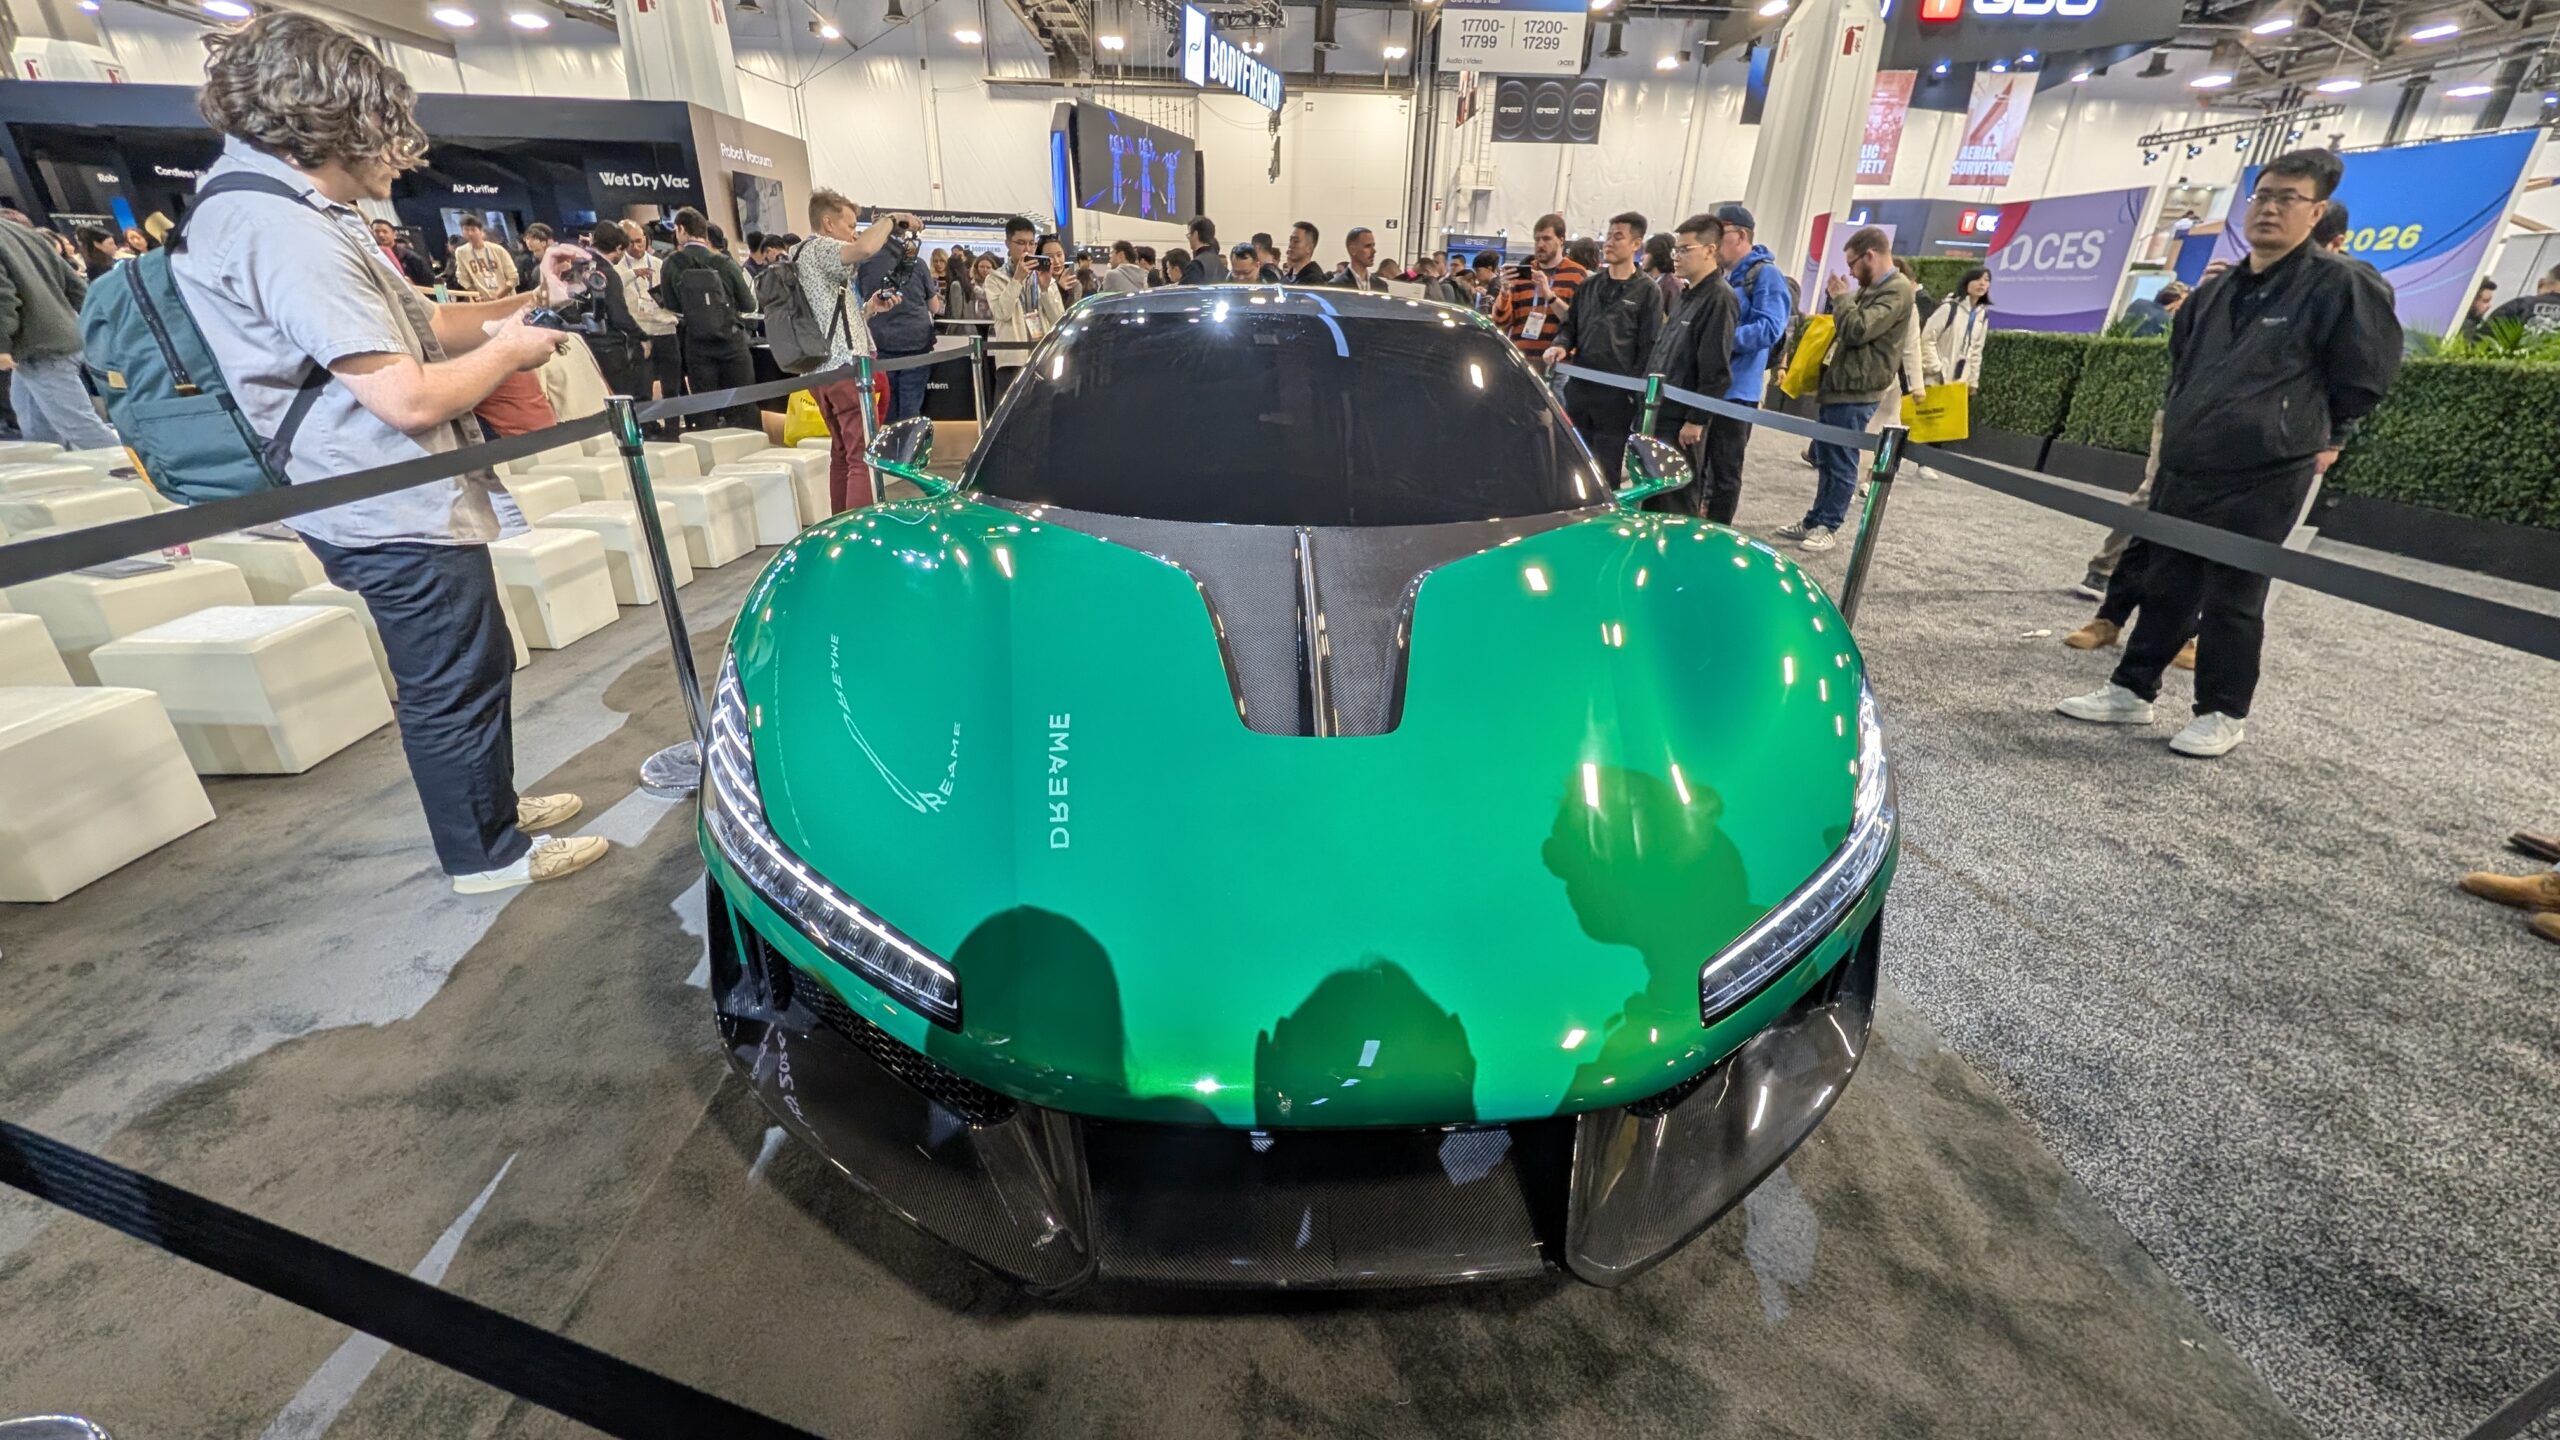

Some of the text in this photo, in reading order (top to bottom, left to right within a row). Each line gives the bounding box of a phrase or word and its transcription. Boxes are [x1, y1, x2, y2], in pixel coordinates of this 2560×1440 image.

[1461, 19, 1505, 32] 17700-
[1524, 20, 1568, 34] 17200-
[1460, 35, 1497, 48] 17799
[1523, 36, 1560, 50] 17299
[1210, 34, 1280, 111] BODYFRIEND
[720, 142, 774, 168] Robot Vacuum
[1960, 145, 1999, 160] AERIAL
[154, 165, 195, 179] Cordless
[1952, 160, 2015, 176] SURVEYING
[600, 172, 690, 190] Wet Dry Vac
[453, 183, 499, 195] Air Purifier
[951, 215, 973, 225] Beyond
[2340, 225, 2423, 251] 2026
[2034, 229, 2105, 271] CES
[469, 259, 498, 274] GAP
